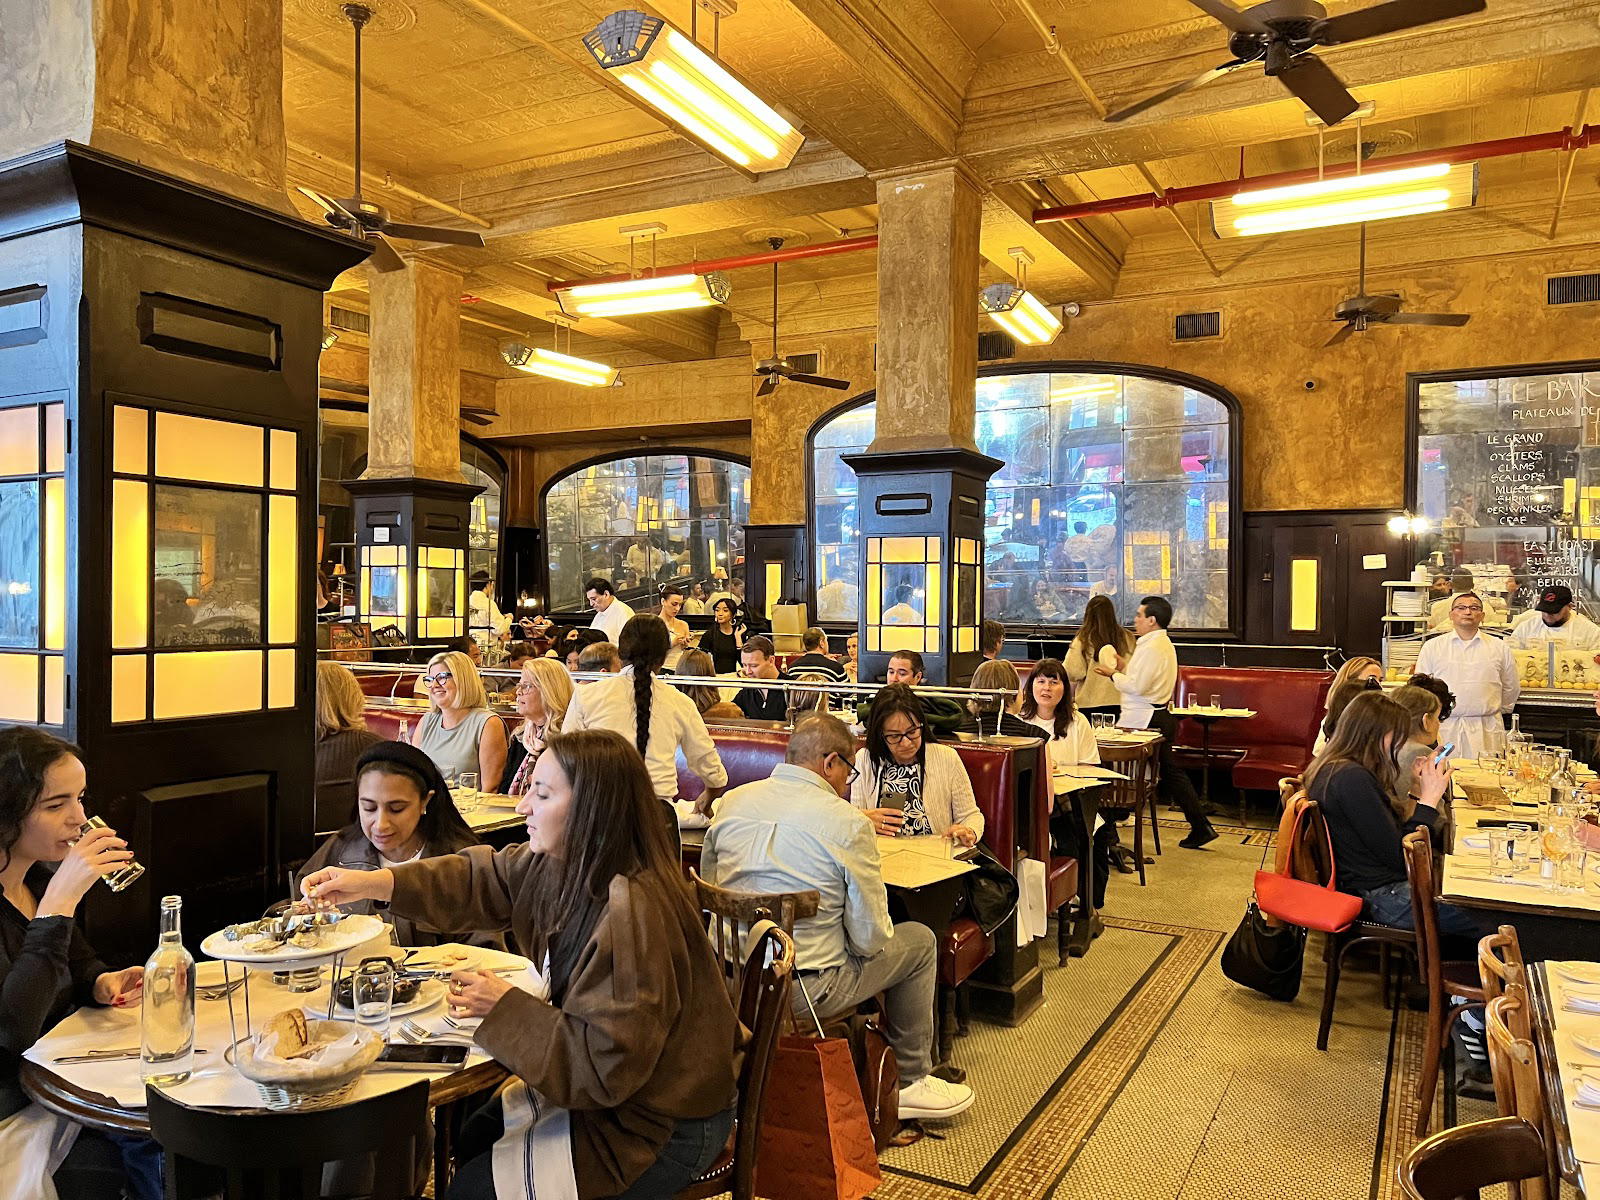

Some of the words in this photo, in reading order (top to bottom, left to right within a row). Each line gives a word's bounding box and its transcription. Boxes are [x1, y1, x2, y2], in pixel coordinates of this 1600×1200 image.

[1512, 382, 1537, 403] LE
[1547, 378, 1600, 401] BAR
[1512, 406, 1574, 420] PLATEAUX
[1487, 434, 1500, 445] LE
[1504, 432, 1544, 444] GRAND
[1489, 450, 1544, 461] OYSTERS
[1498, 462, 1535, 473] CLAMS
[1490, 472, 1546, 484] SCALLOPS
[1523, 540, 1554, 551] EAST
[1558, 540, 1597, 551] COAST
